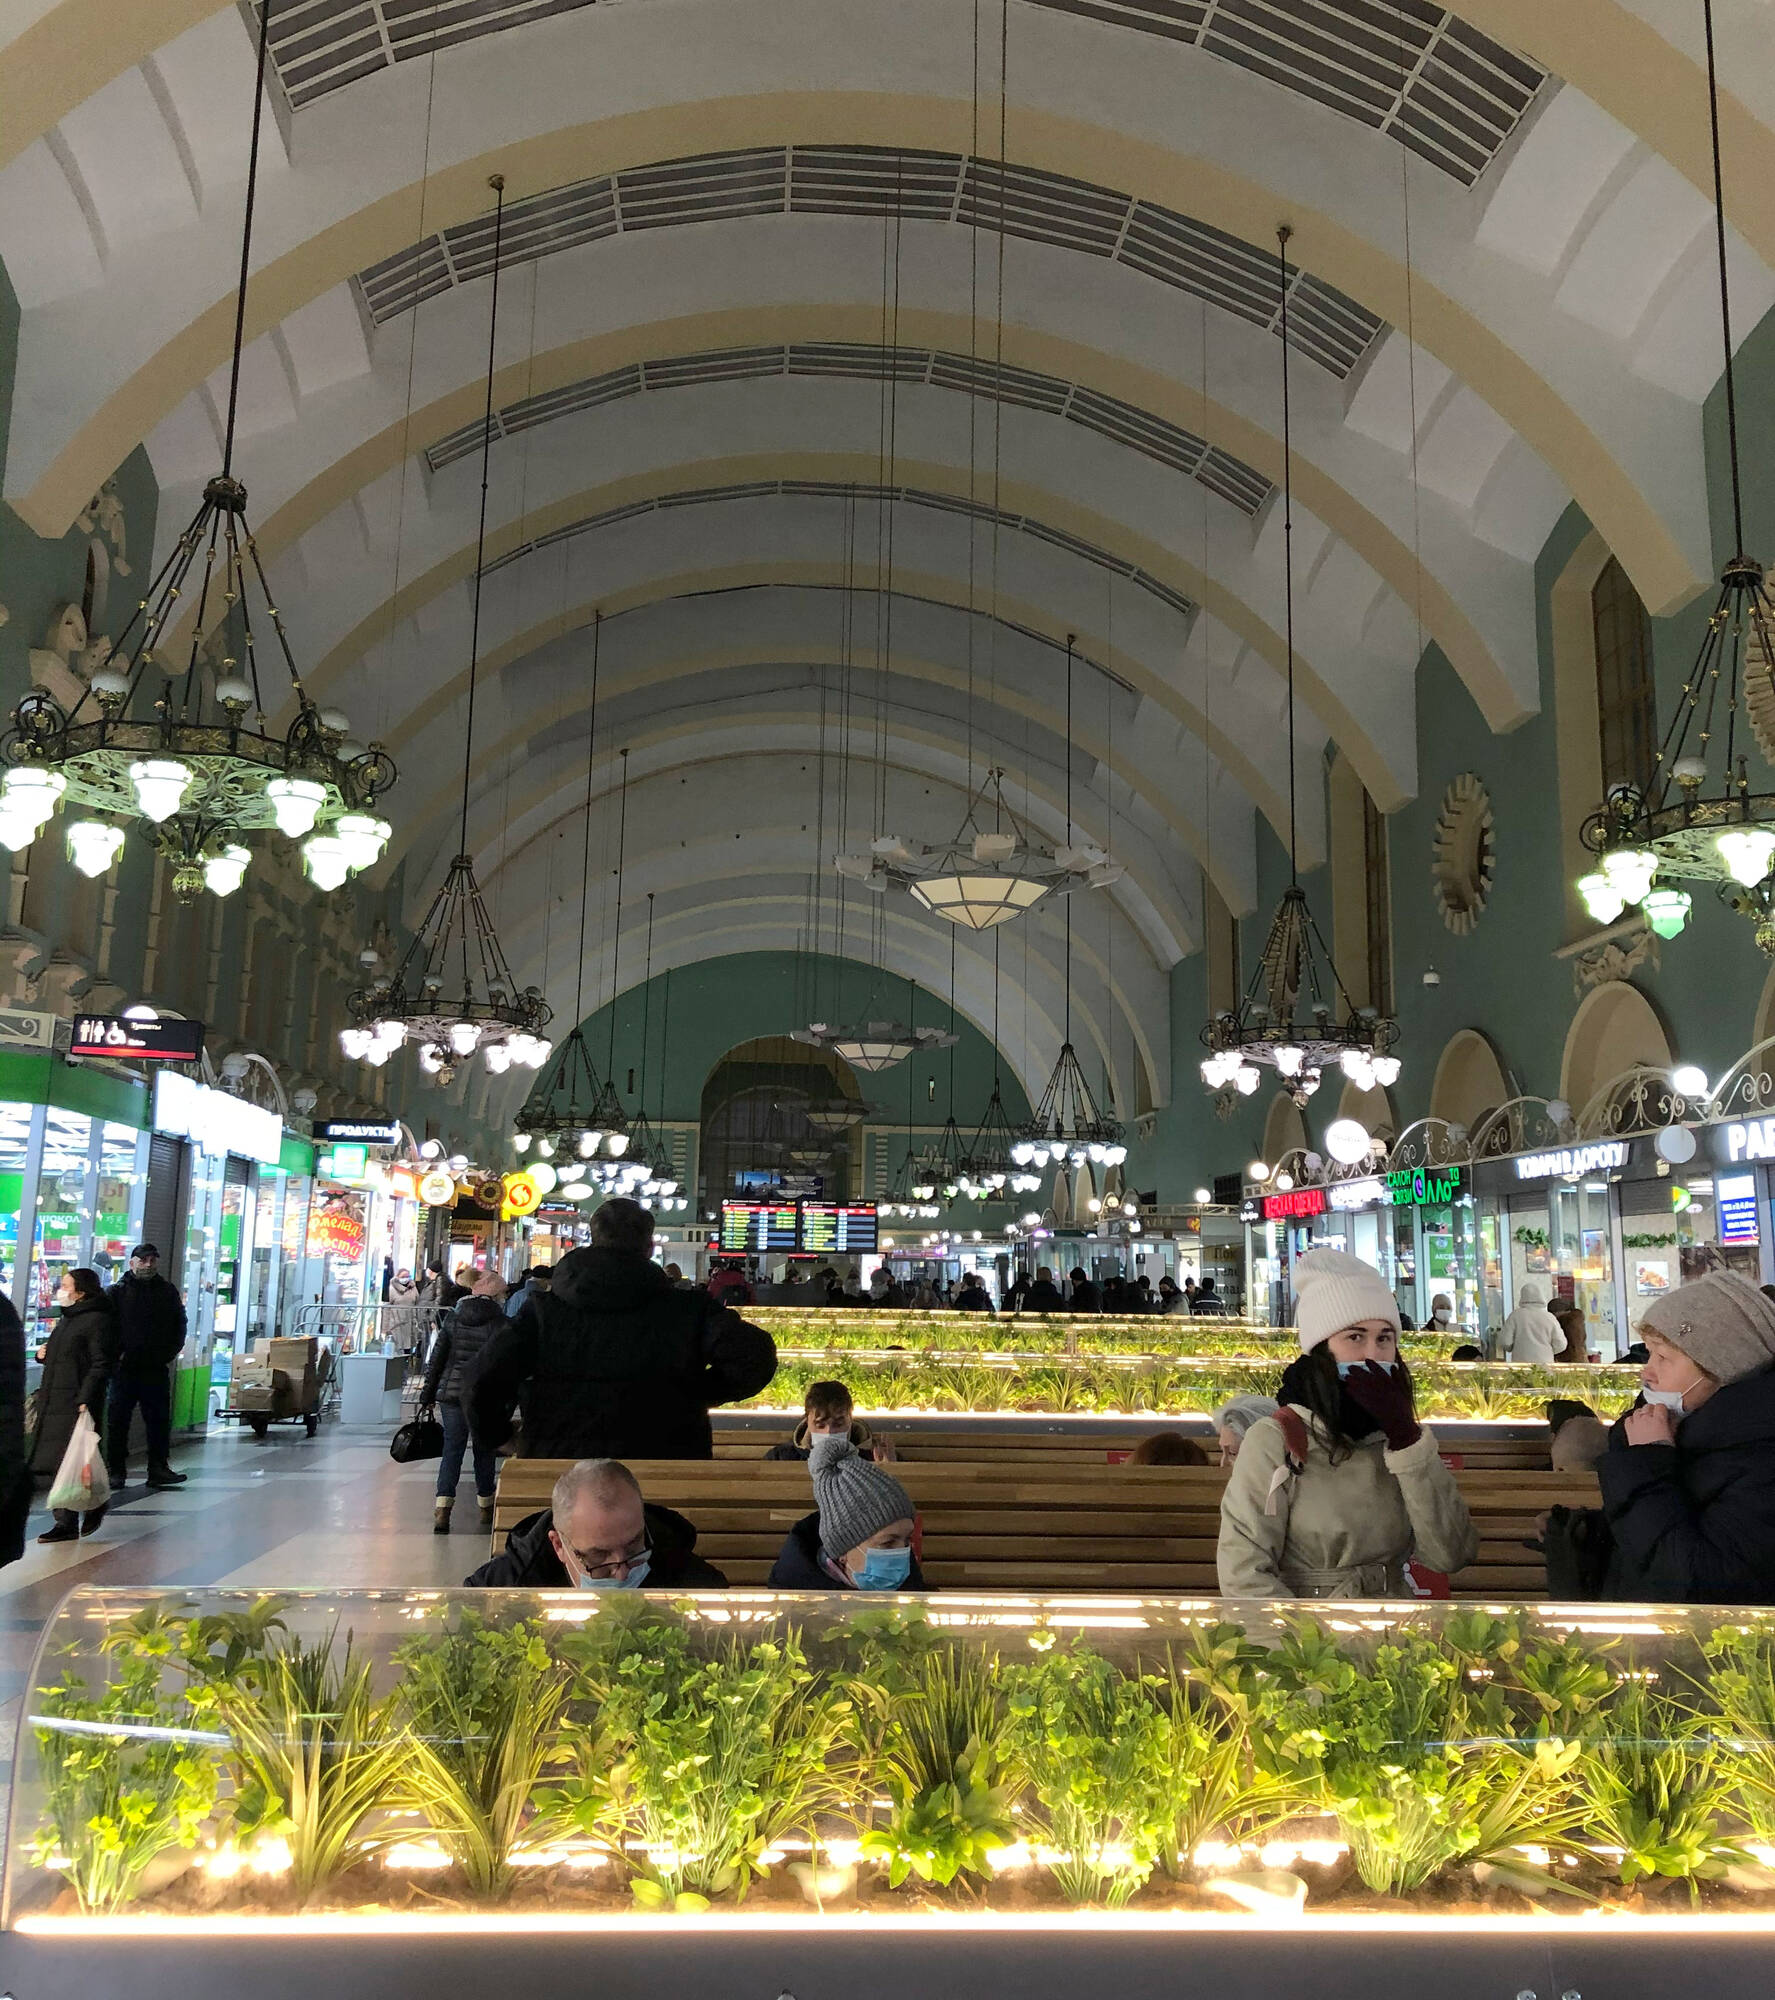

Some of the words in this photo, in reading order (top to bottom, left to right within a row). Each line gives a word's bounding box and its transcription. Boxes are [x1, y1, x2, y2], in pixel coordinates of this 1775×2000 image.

[328, 1125, 398, 1138] ПРОДУКТЫ
[1517, 1152, 1562, 1179] ТОВАРЫ
[1562, 1150, 1572, 1173] В
[1572, 1142, 1624, 1175] ДОРОГУ
[1387, 1170, 1411, 1187] САЛОН
[1392, 1189, 1413, 1205] СВЯЗИ
